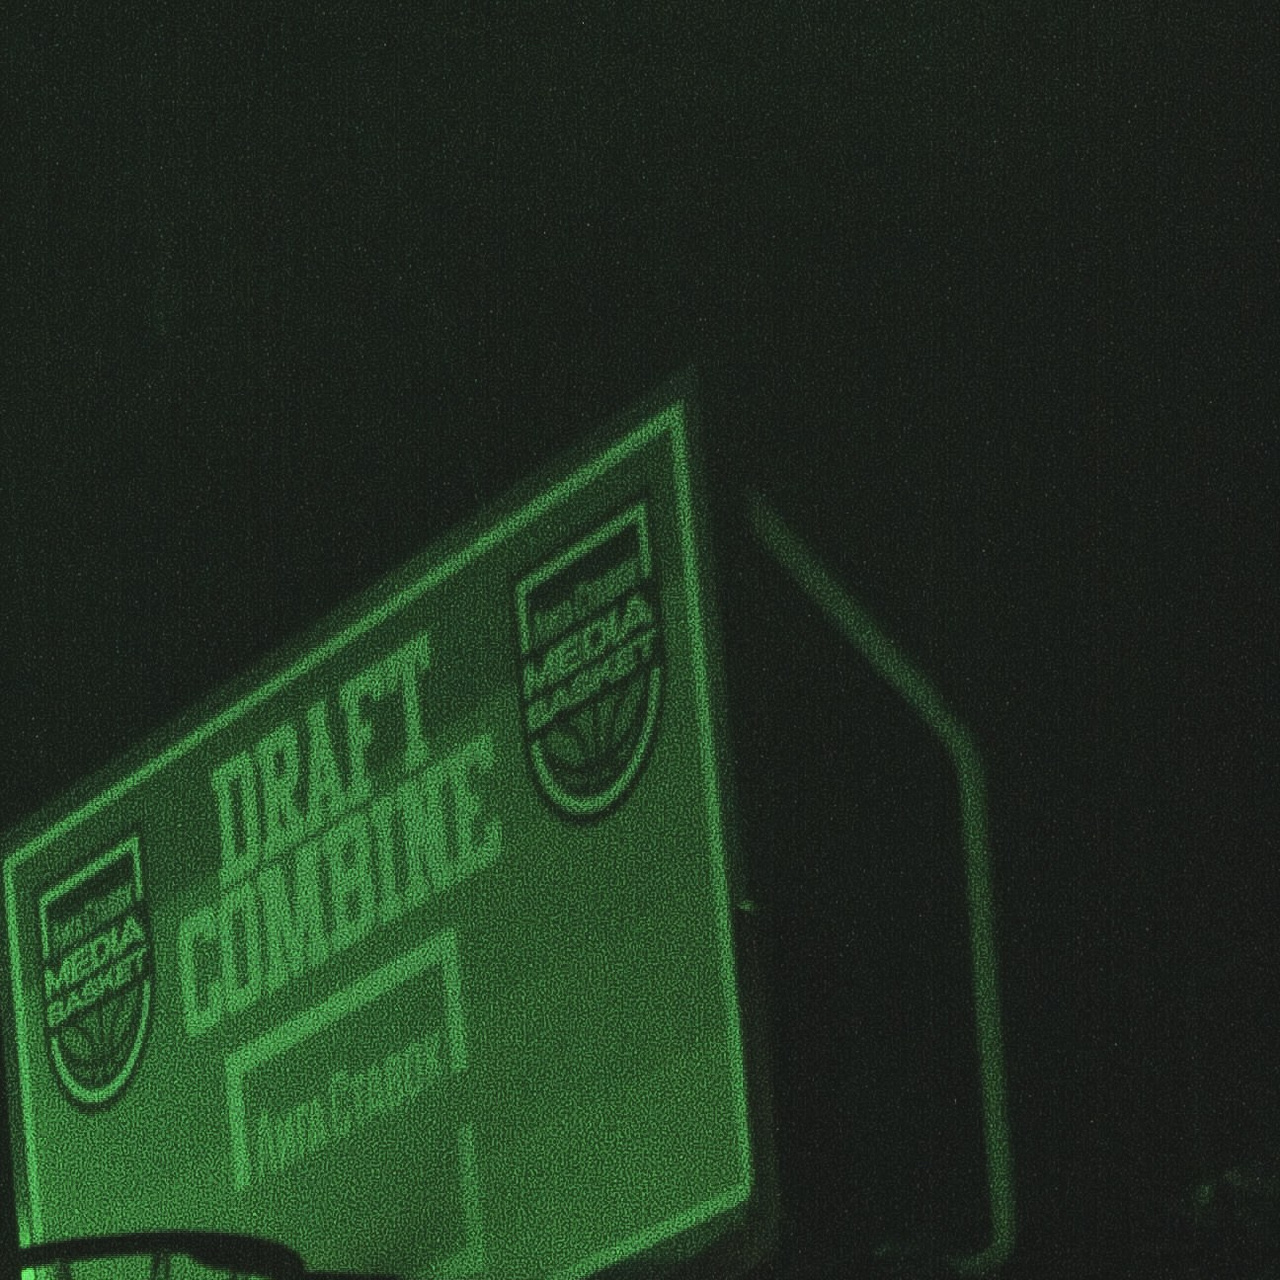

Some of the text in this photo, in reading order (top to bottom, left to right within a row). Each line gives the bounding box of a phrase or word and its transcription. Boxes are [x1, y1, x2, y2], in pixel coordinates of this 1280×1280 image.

[523, 592, 654, 699] MEDIA
[526, 627, 658, 731] BASKET
[211, 631, 430, 891] DRAFT
[178, 732, 502, 1037] COMBINE
[44, 915, 144, 998] MEDIA
[47, 945, 149, 1028] BASKET
